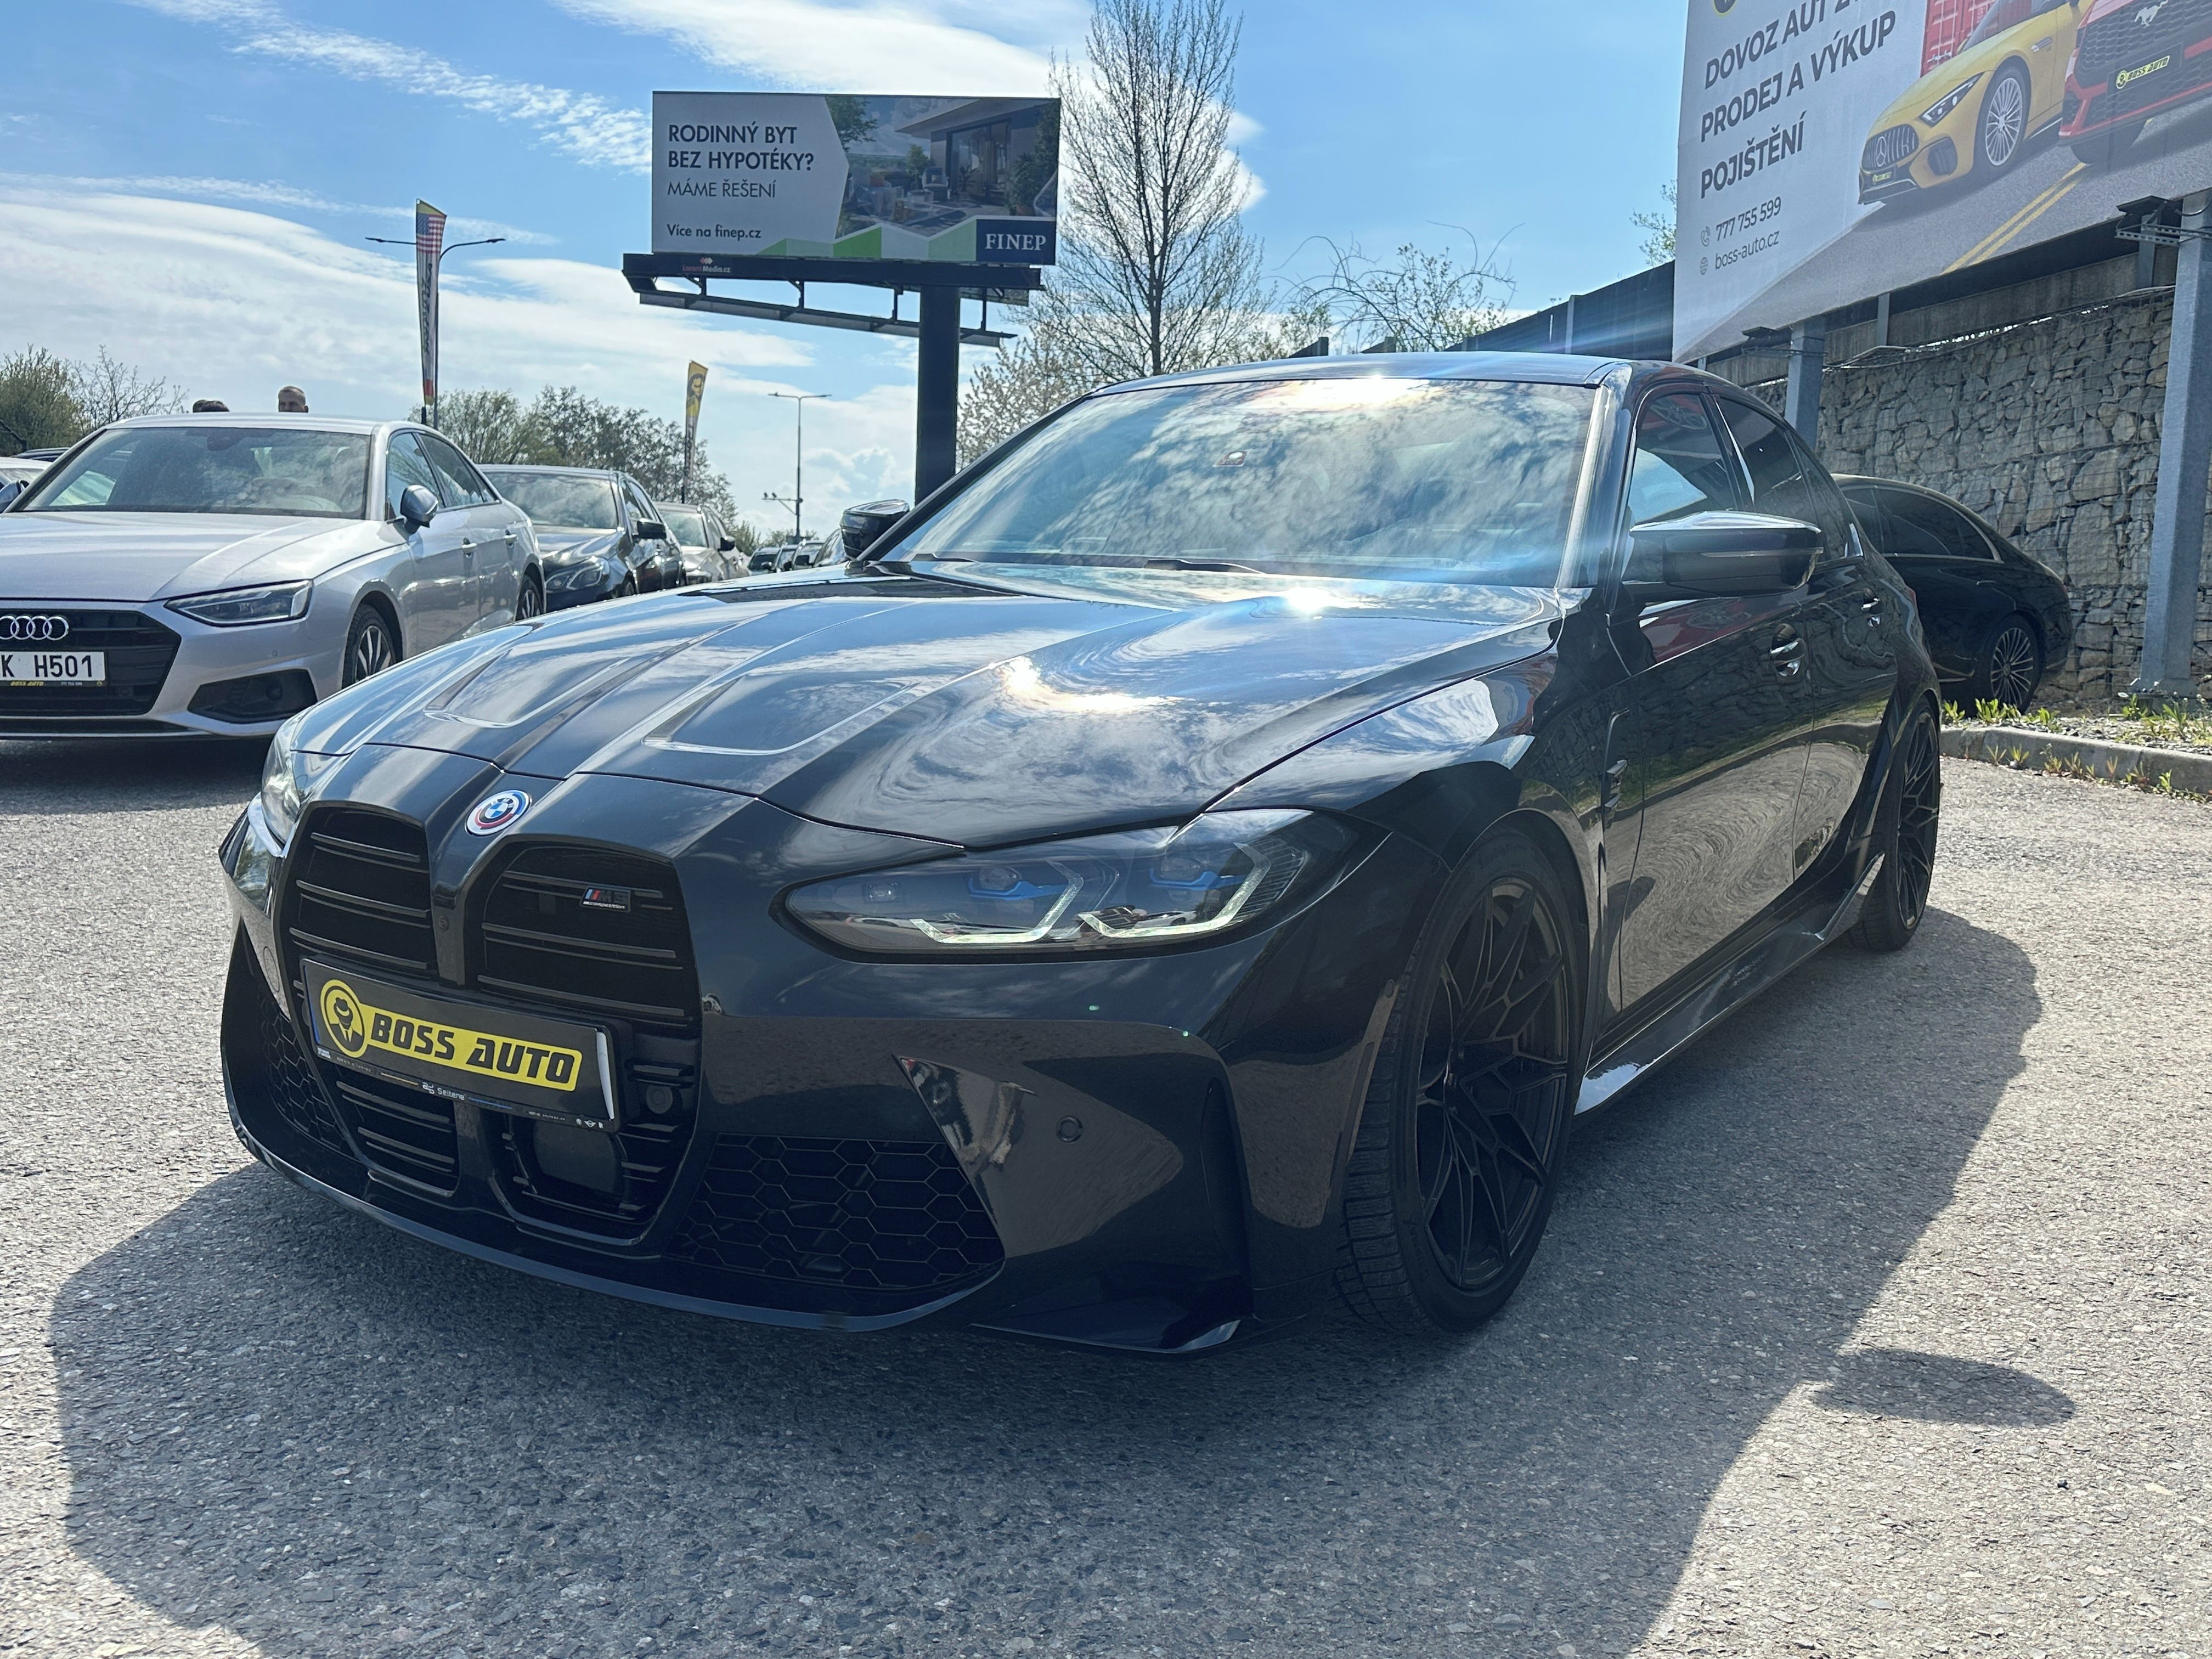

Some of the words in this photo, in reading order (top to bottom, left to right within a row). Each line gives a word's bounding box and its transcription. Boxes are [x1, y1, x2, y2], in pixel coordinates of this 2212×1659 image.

[1705, 19, 1779, 89] DOVOZ
[1781, 0, 1826, 45] AUT
[1701, 71, 1783, 143] PRODEJ
[1786, 62, 1804, 97] A
[1810, 10, 1896, 82] VÝKUP
[2128, 66, 2146, 81] BOSS
[668, 121, 759, 144] RODINNÝ
[764, 126, 798, 144] BYT
[668, 150, 701, 168] BEZ
[708, 148, 814, 171] HYPOTÉKY?
[1701, 110, 1807, 199] POJIŠTĚNÍ
[667, 178, 717, 198] MÁME
[722, 180, 777, 199] ŘEŠENÍ
[1715, 217, 1736, 242] 777
[1738, 207, 1757, 232] 755
[1759, 196, 1781, 222] 599
[667, 224, 692, 237] Více
[696, 228, 712, 238] na
[715, 225, 762, 240] finep.cz
[985, 233, 1047, 251] FINEP
[1714, 230, 1780, 270] boss-auto.cz
[1, 655, 15, 678] K
[34, 654, 92, 678] H501
[371, 1013, 455, 1061] BOSS
[465, 1037, 576, 1084] AUTO
